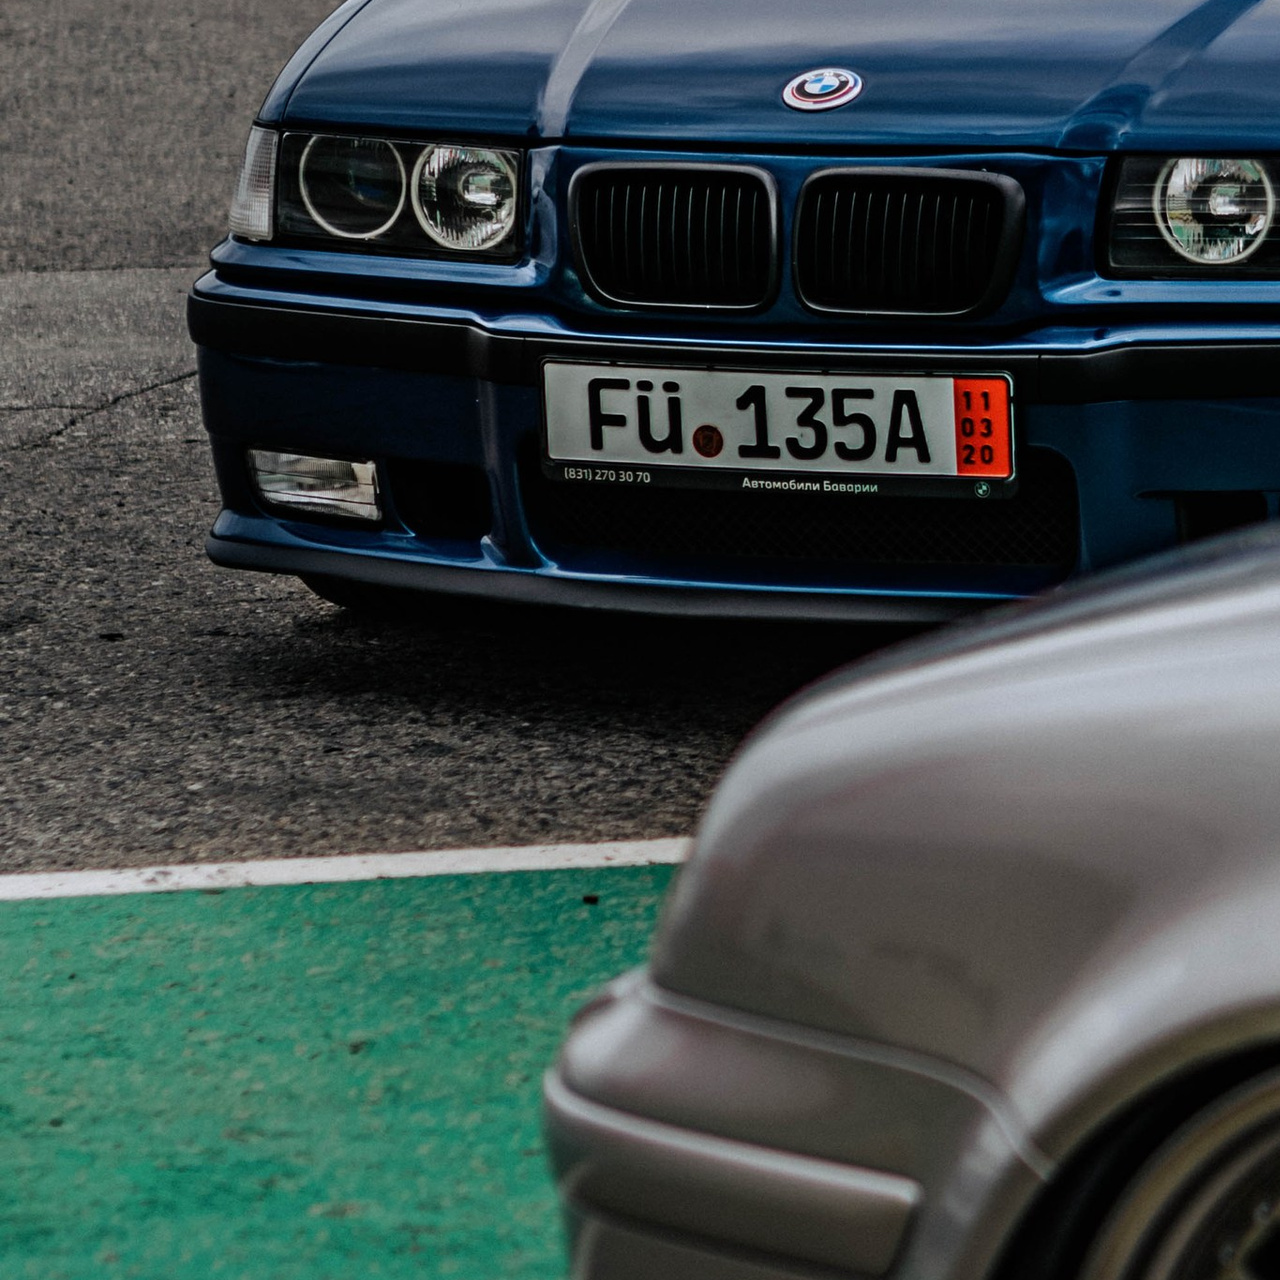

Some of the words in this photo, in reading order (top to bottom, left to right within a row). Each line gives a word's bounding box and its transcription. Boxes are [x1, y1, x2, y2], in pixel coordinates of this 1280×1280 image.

[963, 391, 990, 411] 11
[736, 385, 931, 463] 135A
[961, 417, 993, 437] 03
[963, 444, 994, 465] 20
[564, 467, 593, 481] (831)
[595, 469, 616, 481] 270
[619, 471, 634, 482] 30
[636, 472, 651, 483] 70
[742, 477, 820, 491] Автомобили
[823, 480, 878, 494] Баварии
